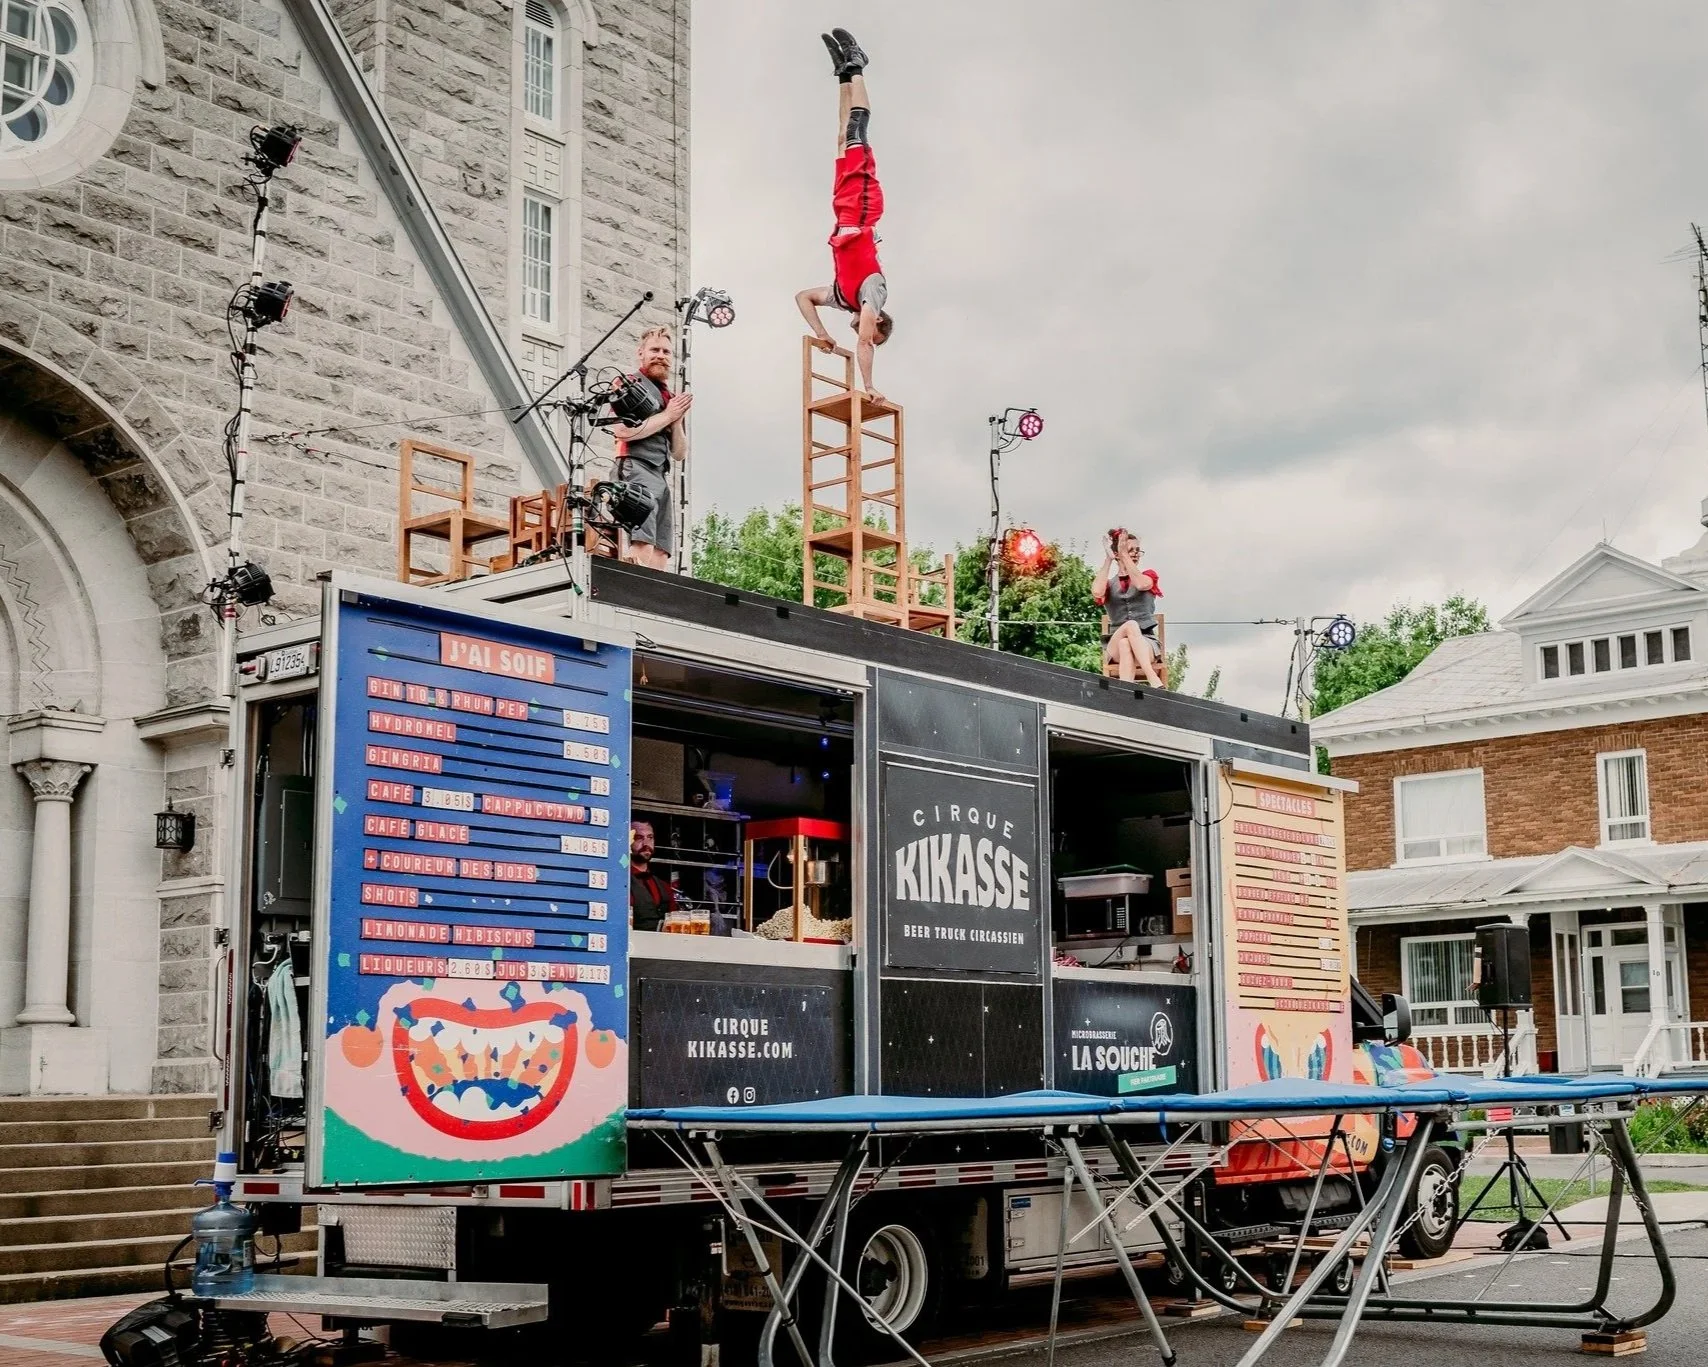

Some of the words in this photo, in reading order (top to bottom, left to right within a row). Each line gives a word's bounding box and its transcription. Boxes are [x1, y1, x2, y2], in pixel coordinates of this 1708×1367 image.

[449, 639, 492, 668] J'AI
[499, 650, 548, 678] SOIF
[370, 680, 401, 697] GIN
[409, 687, 427, 702] TO
[452, 693, 492, 712] RHUM
[497, 701, 527, 718] PEP
[371, 714, 455, 740] HYDROMEL
[367, 748, 441, 771] GINGRIA
[370, 783, 411, 801] CAFÉ
[483, 797, 585, 821] CAPPUCCINO
[1260, 791, 1313, 816] SPECTACLES
[366, 819, 409, 836] CAFÉ
[417, 822, 467, 842] GLACÉ
[912, 804, 1015, 840] CIRQUE
[382, 854, 455, 875] COUREUR
[461, 863, 491, 877] DES
[496, 864, 536, 880] BOIS
[895, 833, 1031, 911] KIKASSE
[364, 887, 417, 905] SHOTS
[364, 922, 448, 941] LIMONADE
[455, 928, 535, 945] HIBISCUS
[903, 924, 931, 939] BEER
[934, 926, 967, 942] TRUCK
[970, 929, 1025, 945] CIRCASSIEN
[361, 957, 446, 974] LIQUEURS
[498, 963, 527, 977] JUS
[549, 965, 577, 979] EAU
[714, 1017, 769, 1039] CIRQUE
[1071, 1029, 1118, 1040] MICROBRASSERIE
[687, 1040, 793, 1059] KIKASSE.COM
[1072, 1045, 1093, 1071] LA
[1095, 1045, 1158, 1071] SOUCHE
